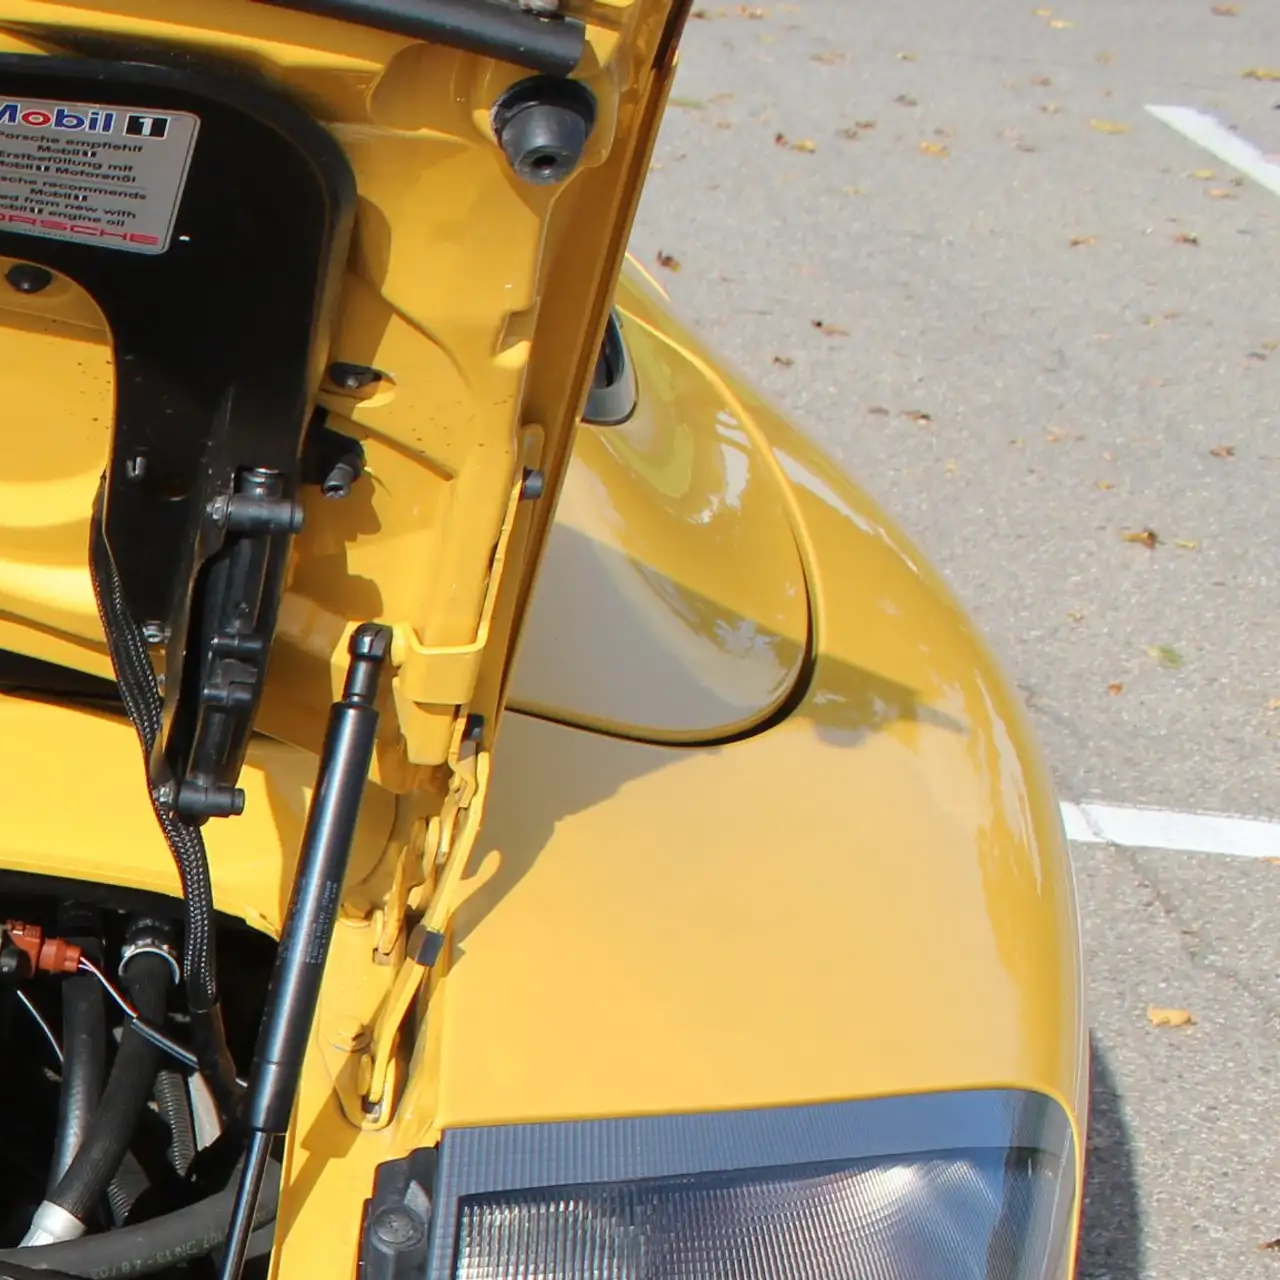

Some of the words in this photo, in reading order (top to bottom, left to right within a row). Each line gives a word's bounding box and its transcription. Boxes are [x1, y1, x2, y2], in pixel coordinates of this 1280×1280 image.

[37, 145, 80, 156] Mobil
[65, 139, 143, 153] empfiehlt
[55, 166, 136, 183] Motorenöl
[108, 163, 134, 173] mit
[29, 188, 72, 200] Mobil
[42, 181, 147, 200] recommends
[24, 196, 60, 208] from
[64, 204, 99, 213] new
[103, 209, 136, 219] with
[48, 210, 102, 221] engine
[106, 219, 125, 228] oil
